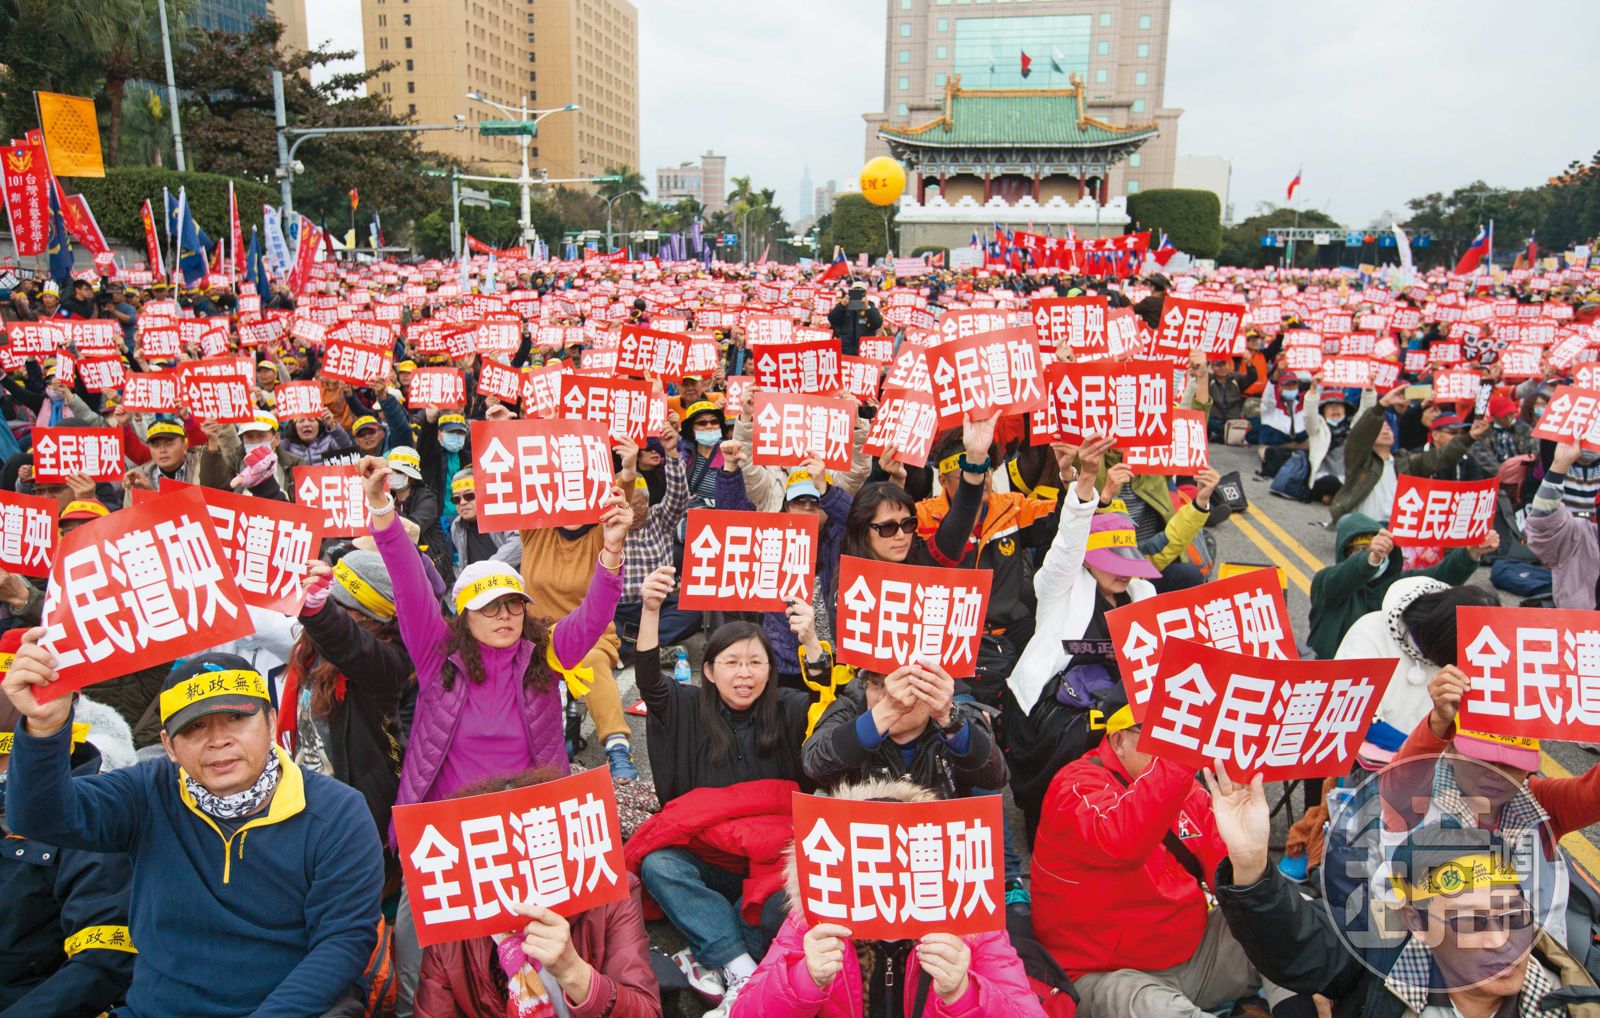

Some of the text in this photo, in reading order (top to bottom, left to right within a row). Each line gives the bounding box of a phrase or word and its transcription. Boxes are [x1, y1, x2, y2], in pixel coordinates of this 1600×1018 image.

[478, 325, 519, 349] 全民遭殃
[747, 319, 791, 344] 全民遭殃
[1035, 304, 1105, 348] 全民遭殃
[1160, 306, 1239, 354] 全民遭殃
[80, 360, 126, 388] 全民遭殃
[324, 344, 379, 380] 全民遭殃
[618, 333, 686, 376] 全民遭殃
[757, 348, 839, 393] 全民遭殃
[934, 338, 1041, 417] 全民遭殃
[124, 378, 176, 408] 全民遭殃
[188, 382, 250, 418] 全民遭殃
[276, 387, 321, 417] 全民遭殃
[409, 374, 454, 403] 全民遭殃
[480, 366, 518, 401] 全民遭殃
[1056, 373, 1168, 439] 全民遭殃
[564, 385, 647, 440] 全民遭殃
[757, 401, 851, 463] 全民遭殃
[868, 399, 938, 457] 全民遭殃
[37, 434, 121, 476] 全民遭殃
[480, 434, 613, 517] 全民遭殃
[299, 476, 374, 528] 全民遭
[1392, 487, 1496, 540] 全民遭殃
[686, 524, 811, 600] 全民遭殃
[842, 575, 983, 666] 全民遭殃
[1151, 662, 1376, 770] 全民遭殃
[409, 792, 618, 925] 全民遭殃
[802, 817, 996, 923] 全民遭殃
[70, 928, 137, 951] 政無
